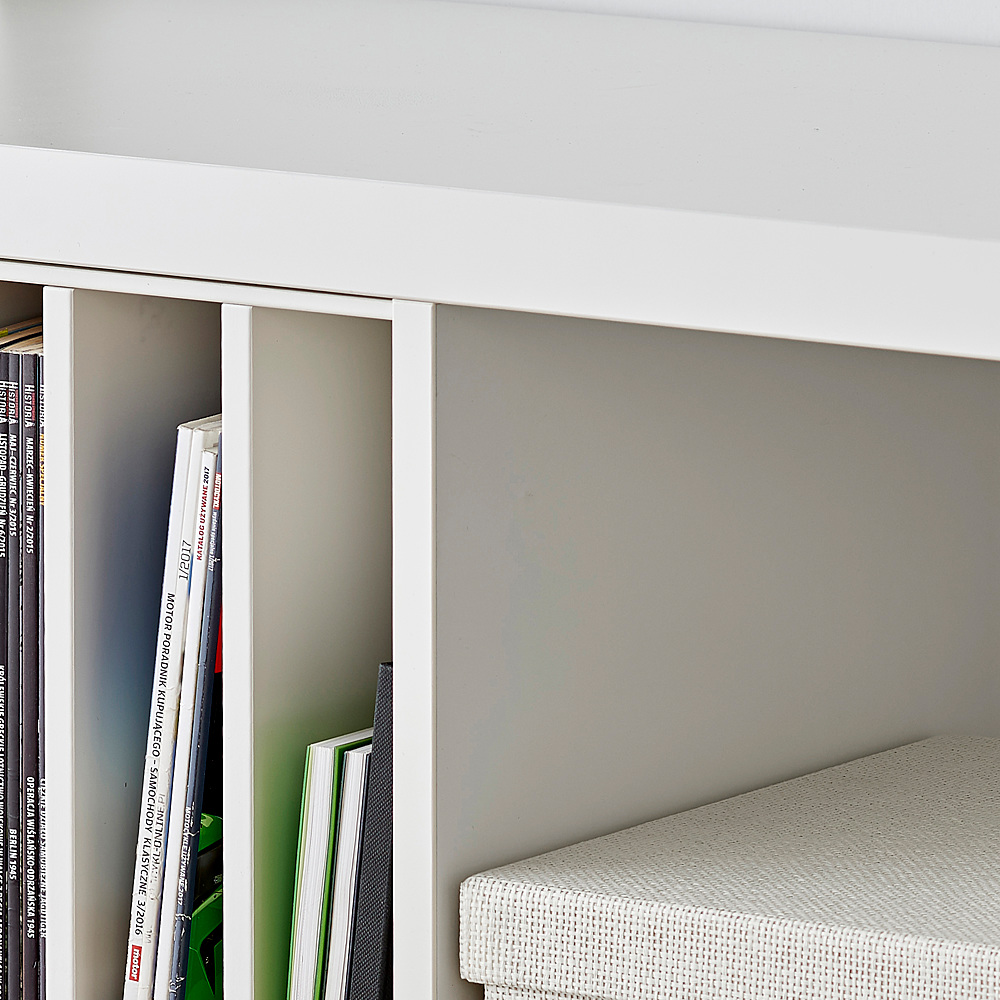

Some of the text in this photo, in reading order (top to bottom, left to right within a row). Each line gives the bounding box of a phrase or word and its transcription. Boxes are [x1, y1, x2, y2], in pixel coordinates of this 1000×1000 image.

[178, 540, 192, 580] 1/2017
[164, 592, 175, 630] MOTOR
[158, 633, 171, 687] PORADNIK
[152, 689, 166, 757] KUPUJĄCEGO
[144, 767, 159, 833] SAMOCHODY
[9, 860, 17, 880] 1945
[138, 837, 151, 896] KLASYCZNE
[27, 918, 35, 938] 1945
[135, 900, 146, 935] 3/2016
[131, 948, 140, 980] motor
